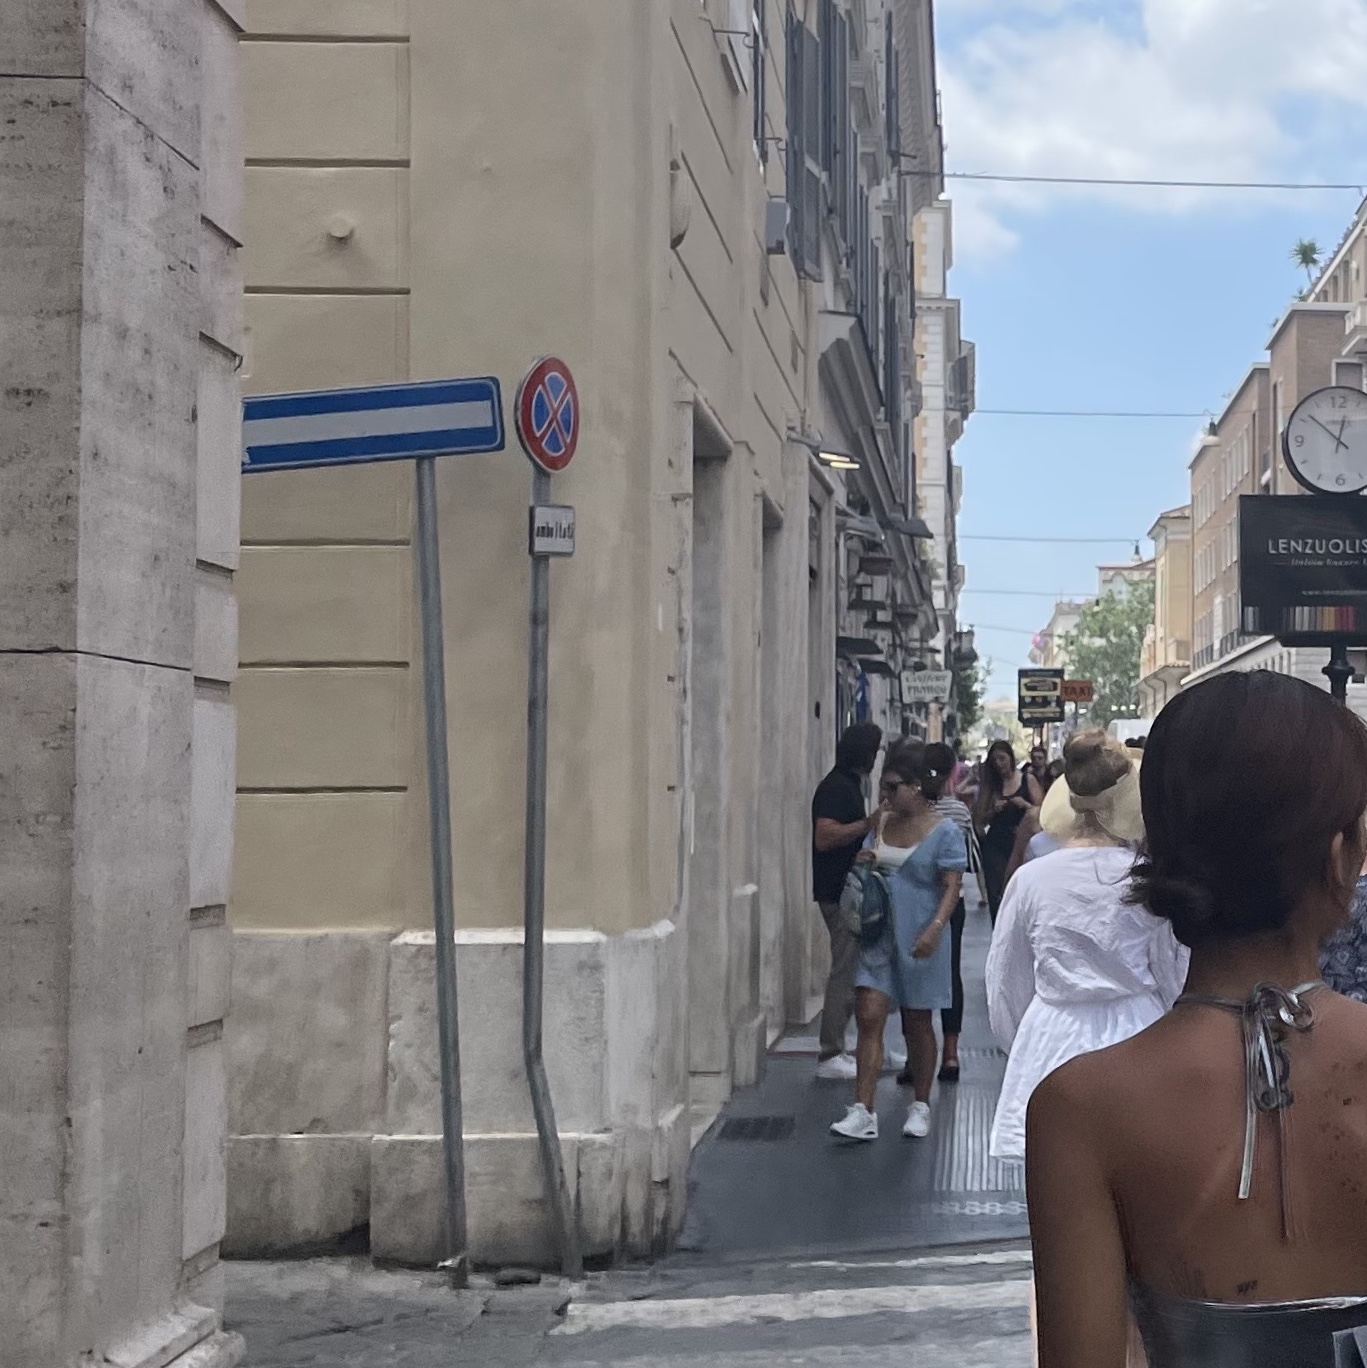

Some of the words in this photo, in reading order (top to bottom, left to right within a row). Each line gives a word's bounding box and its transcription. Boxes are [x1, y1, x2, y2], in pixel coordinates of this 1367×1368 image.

[1330, 396, 1347, 409] 12
[1294, 434, 1305, 448] 9
[1335, 473, 1346, 486] 6
